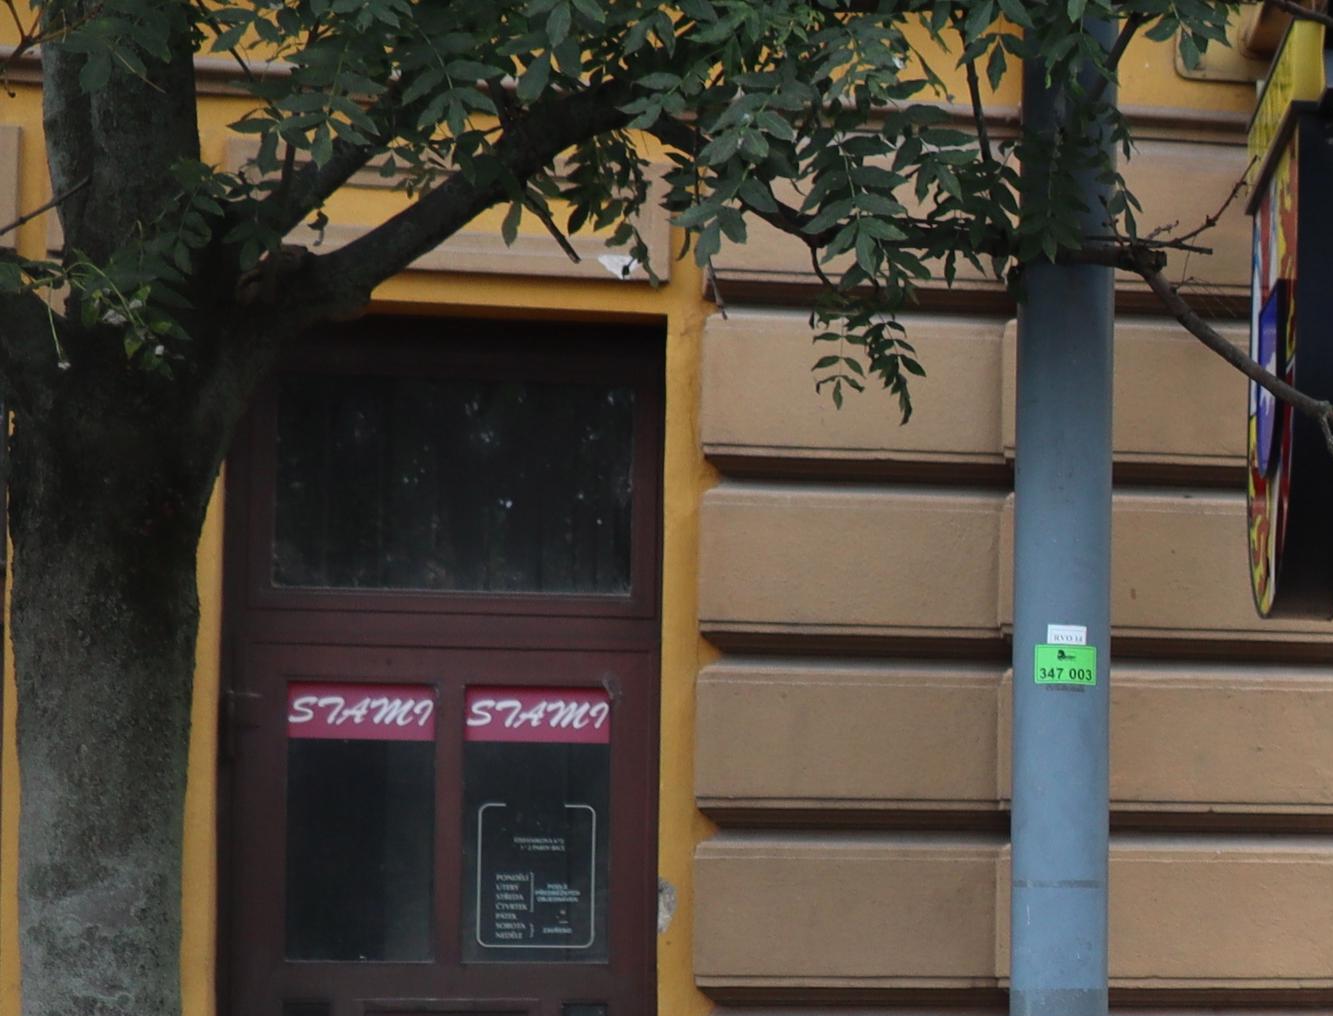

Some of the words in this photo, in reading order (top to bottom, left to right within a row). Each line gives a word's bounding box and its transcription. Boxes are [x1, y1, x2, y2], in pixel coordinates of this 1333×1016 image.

[1039, 667, 1064, 679] 347
[1069, 668, 1092, 681] 003
[288, 696, 434, 727] STAMI
[466, 699, 609, 729] STAMI
